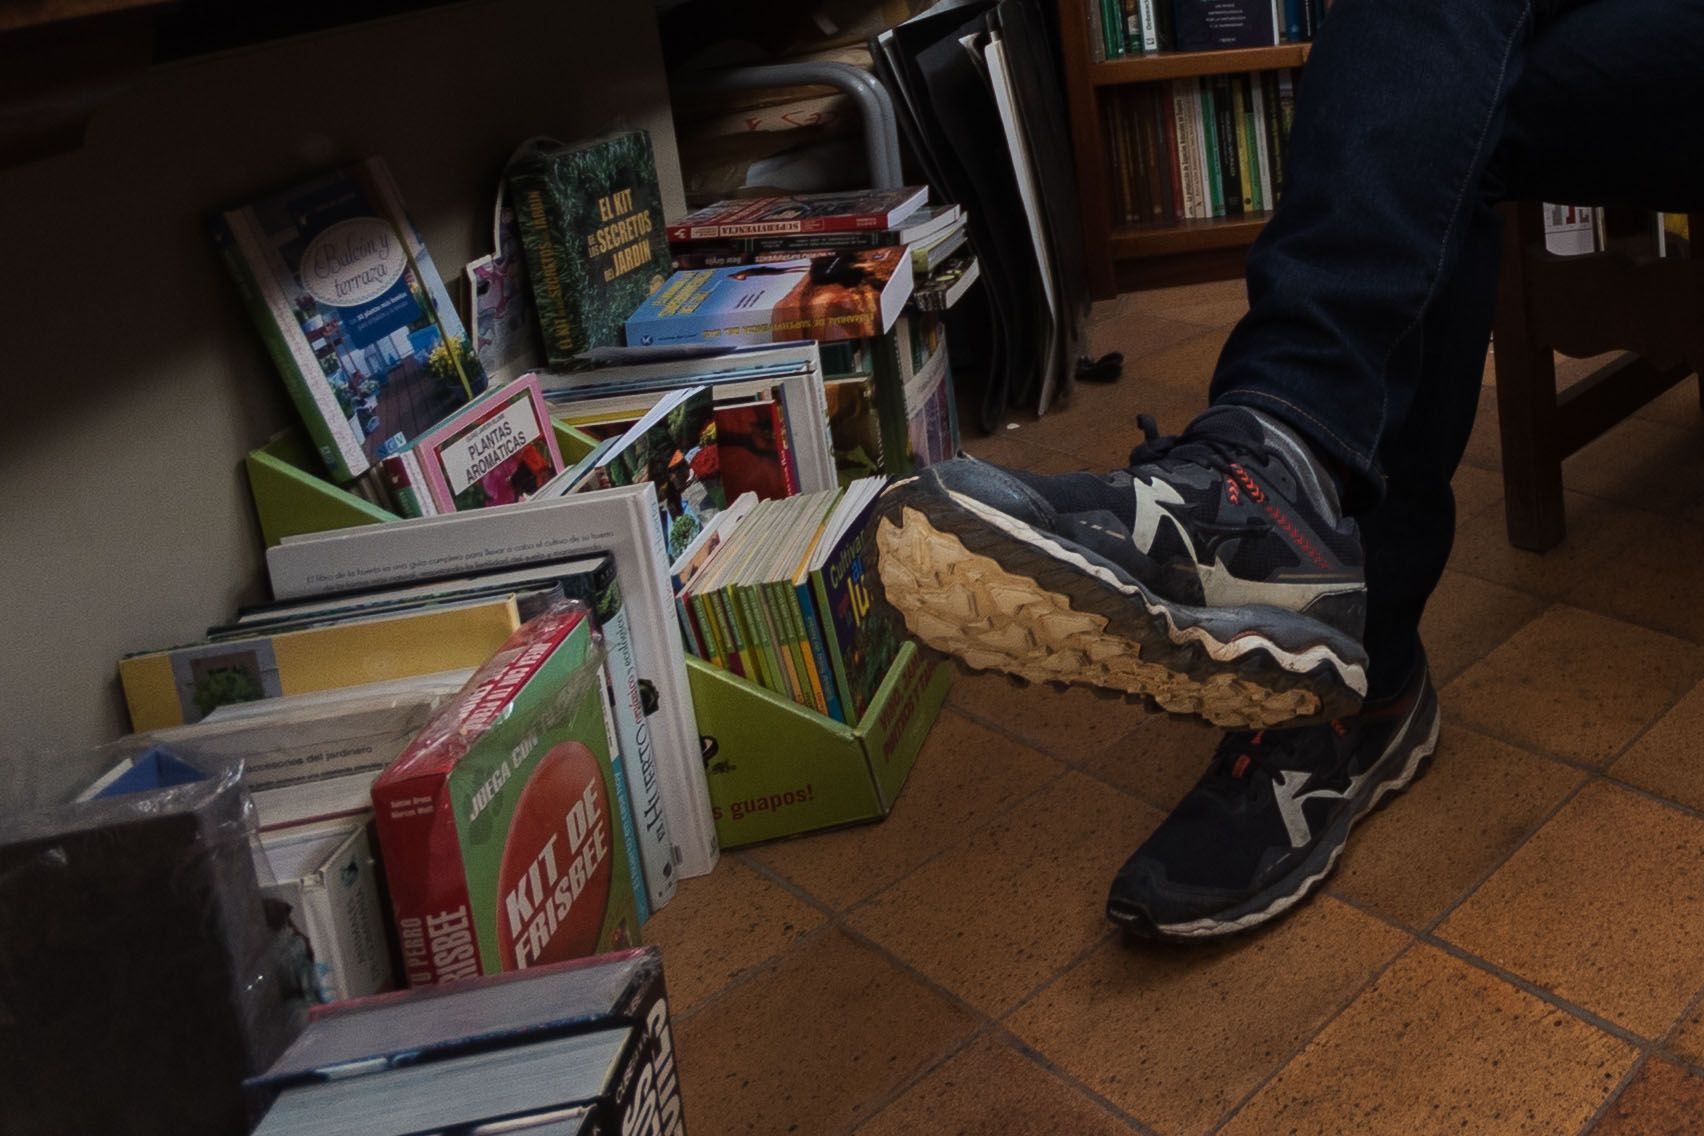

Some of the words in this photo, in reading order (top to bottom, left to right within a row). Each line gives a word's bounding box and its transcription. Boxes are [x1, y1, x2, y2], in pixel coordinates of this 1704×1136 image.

[598, 196, 614, 222] EL
[613, 188, 633, 216] KIT
[596, 209, 653, 254] SECRETOS
[721, 222, 800, 236] SUPERVIVENCIA
[335, 264, 387, 298] terraza
[468, 421, 513, 460] PLANTAS
[469, 763, 513, 823] JUEGA
[510, 736, 540, 770] CON
[635, 722, 662, 831] HUERTO
[730, 784, 814, 821] guapos!
[655, 828, 666, 842] EL
[505, 833, 559, 940] KIT
[565, 777, 601, 856] DE
[514, 820, 609, 971] FRISBEE
